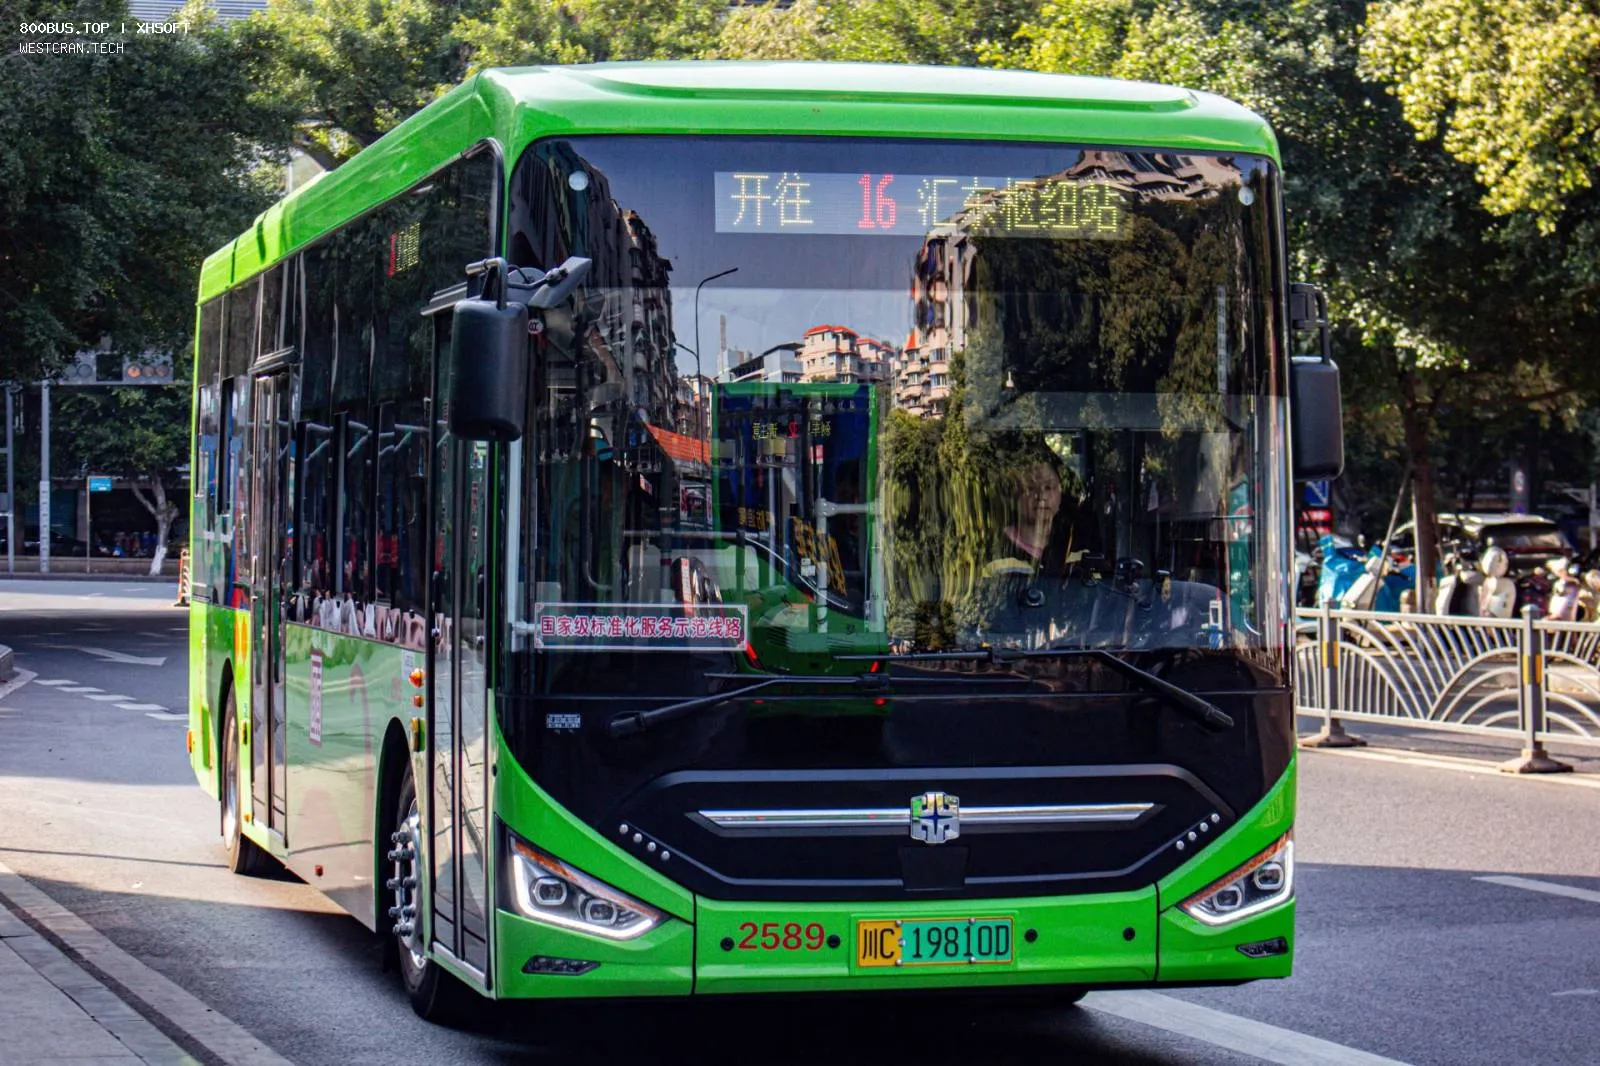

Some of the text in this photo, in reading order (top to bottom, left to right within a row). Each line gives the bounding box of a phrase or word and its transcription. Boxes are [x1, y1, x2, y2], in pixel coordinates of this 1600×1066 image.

[731, 172, 813, 226] 开往
[857, 173, 896, 229] 16
[540, 615, 741, 638] 国家级标准化服务示范线路
[738, 922, 825, 951] 2589
[862, 924, 1010, 960] 川C 19810D
